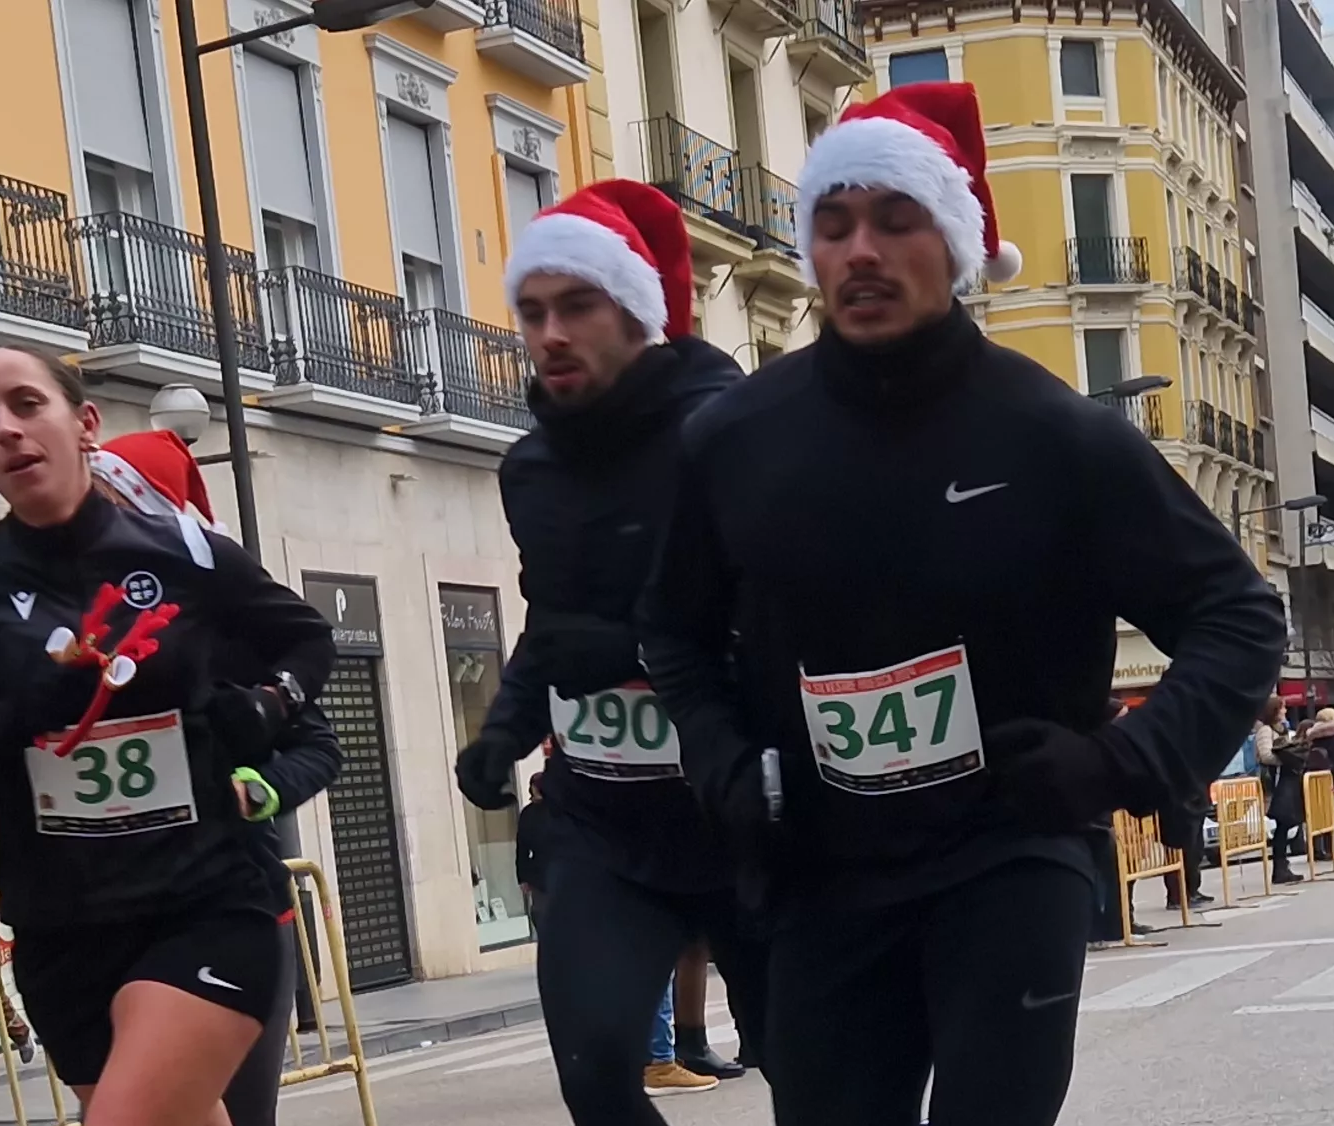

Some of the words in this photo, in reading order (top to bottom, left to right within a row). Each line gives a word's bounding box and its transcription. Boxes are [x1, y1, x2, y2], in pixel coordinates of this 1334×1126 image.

[1114, 663, 1167, 679] ankinter
[567, 692, 670, 751] 290
[817, 674, 957, 761] 347
[71, 738, 156, 805] 38
